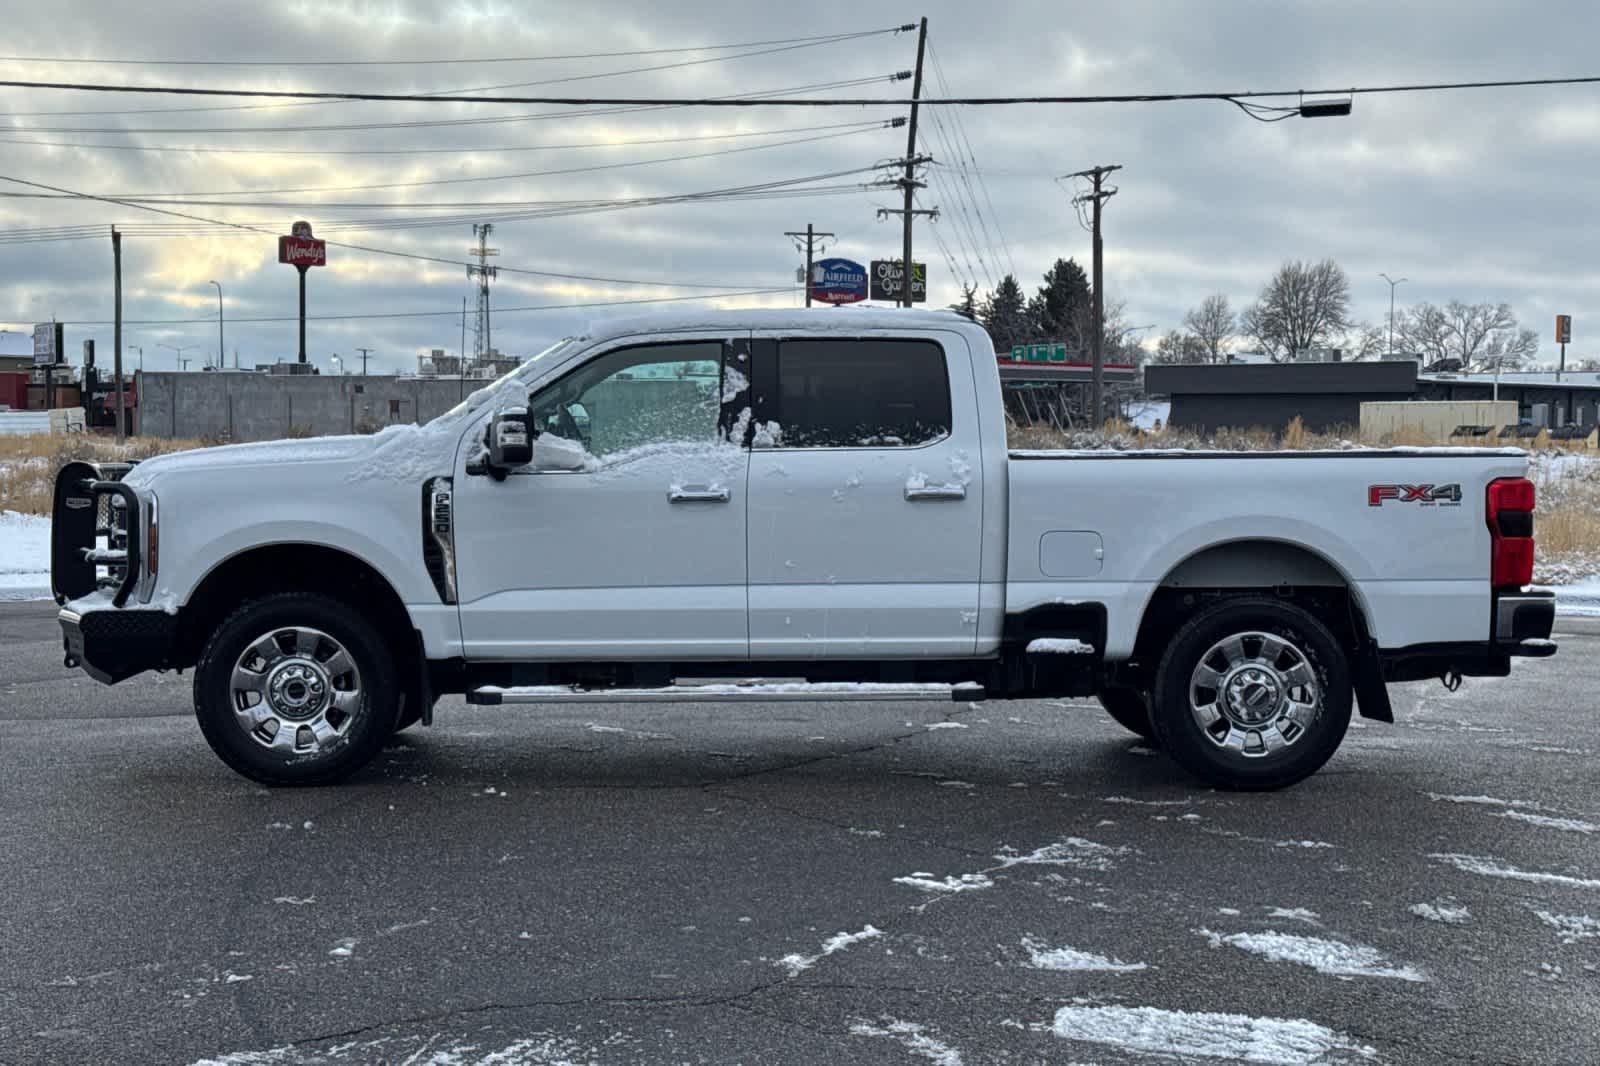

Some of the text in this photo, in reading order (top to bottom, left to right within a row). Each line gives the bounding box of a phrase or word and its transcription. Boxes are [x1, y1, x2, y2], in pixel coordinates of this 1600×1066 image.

[287, 241, 325, 263] Wendy's
[877, 263, 905, 279] Oliv
[881, 278, 926, 295] Gaen
[1368, 484, 1462, 506] FX4
